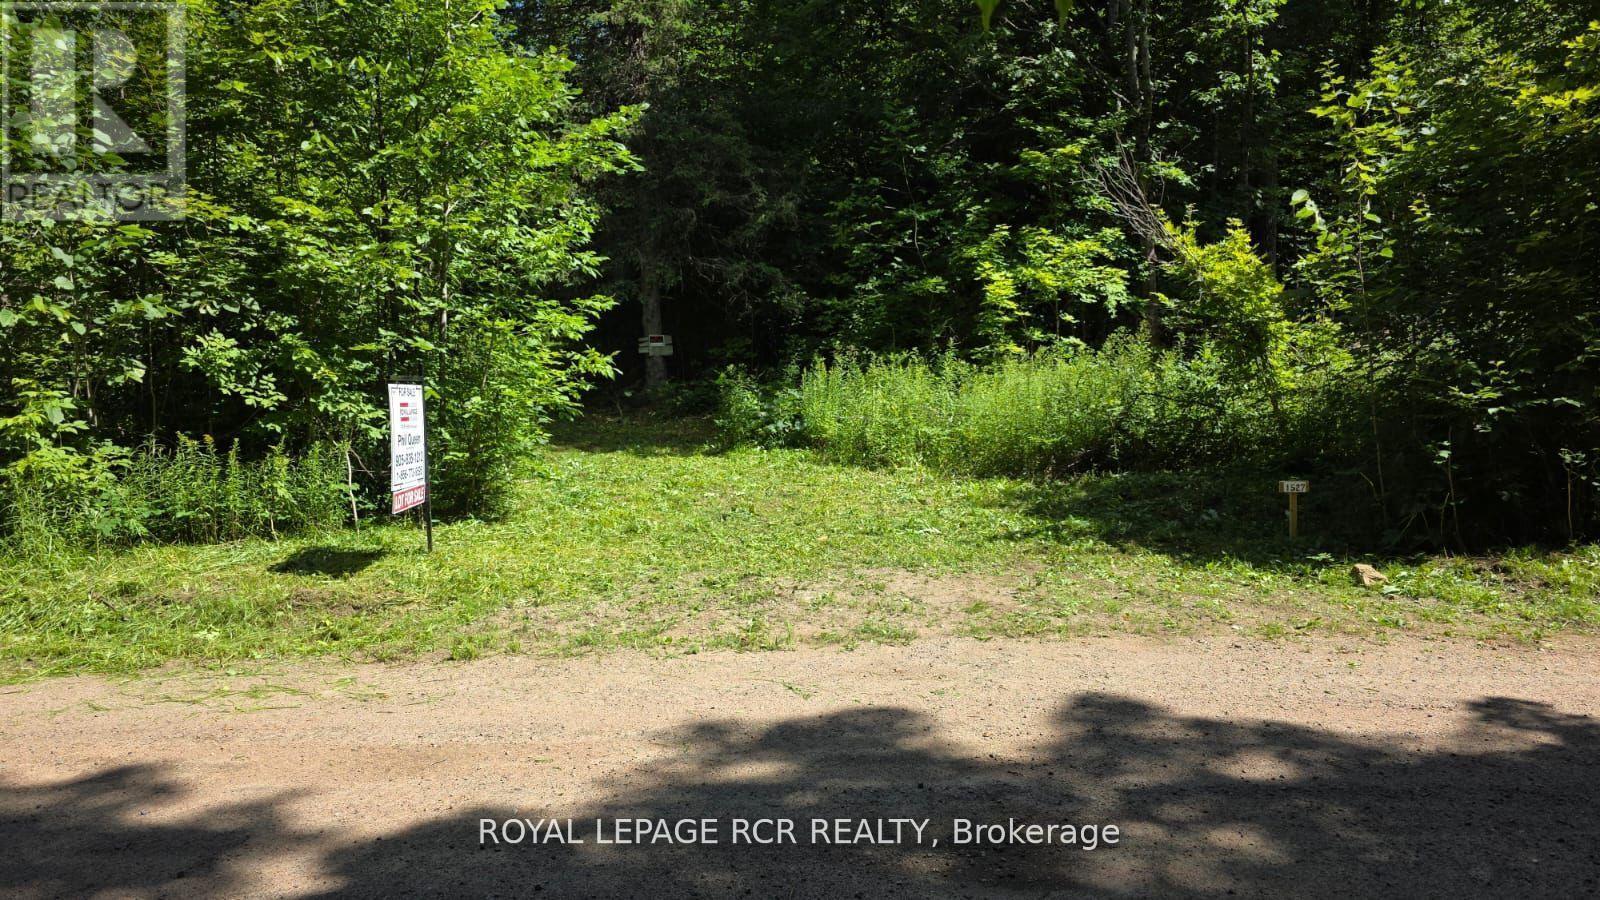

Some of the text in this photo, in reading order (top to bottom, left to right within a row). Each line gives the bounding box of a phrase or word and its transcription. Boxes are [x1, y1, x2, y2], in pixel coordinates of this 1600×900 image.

[398, 433, 421, 446] Phil Queen
[1285, 483, 1306, 492] 1527
[395, 487, 424, 510] LOT FOR SALE
